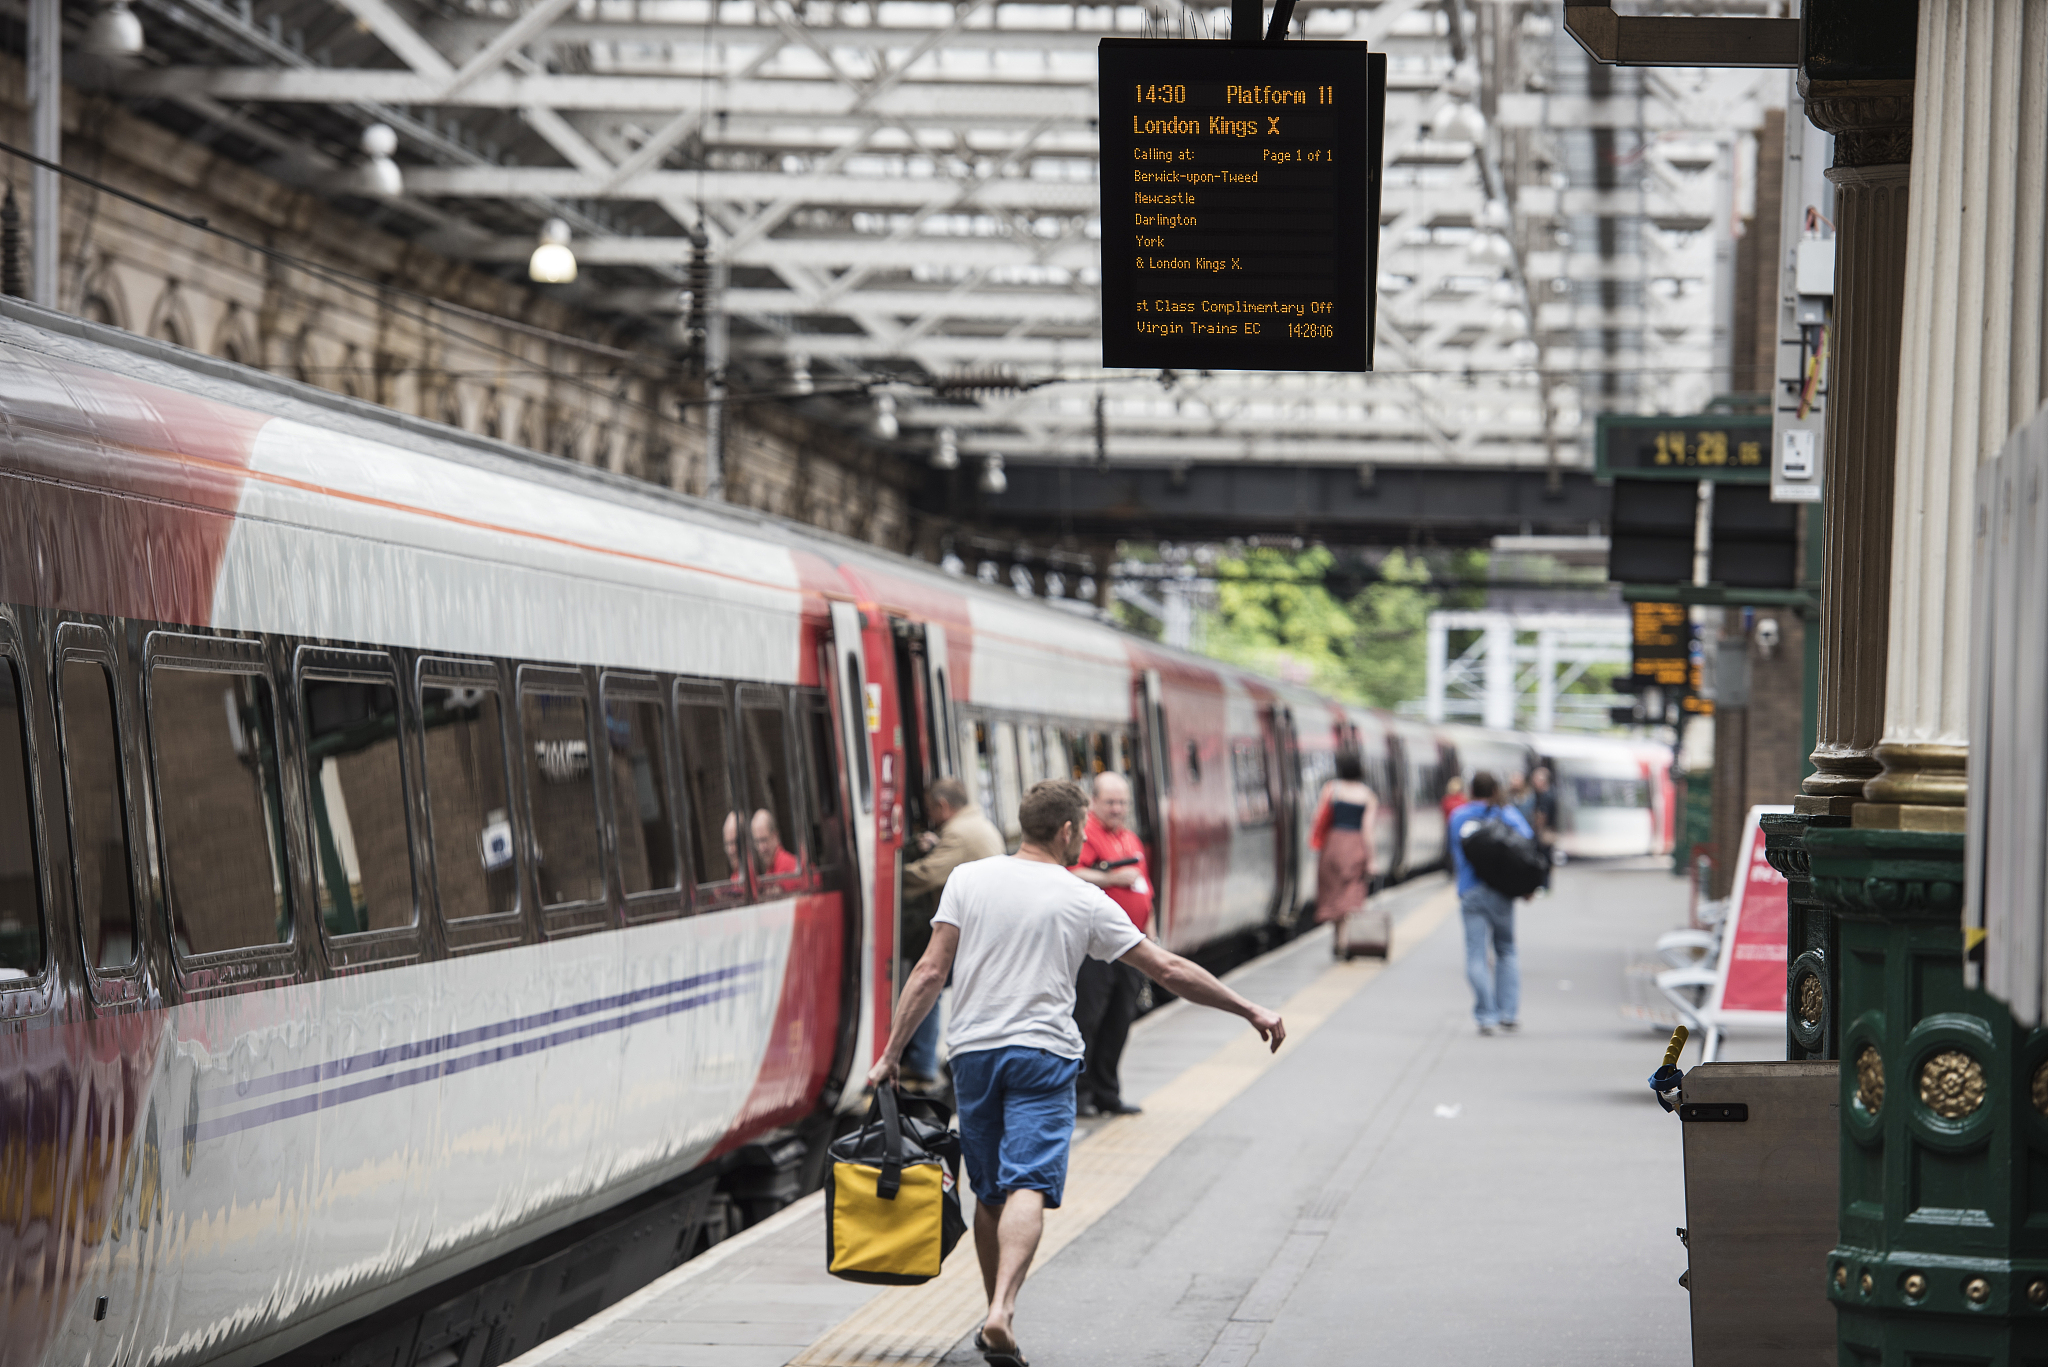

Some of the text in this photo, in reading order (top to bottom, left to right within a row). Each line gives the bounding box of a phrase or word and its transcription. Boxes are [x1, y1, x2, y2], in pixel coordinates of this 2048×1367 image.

[1135, 84, 1333, 105] 14:30 Platform 11
[1133, 115, 1280, 138] London Kings X
[1133, 147, 1333, 165] Calling at: Page 1 of 1
[1134, 169, 1258, 186] Berwick-upon-Tweed
[1134, 191, 1195, 205] Newcastle
[1135, 213, 1197, 229] Darlington
[1135, 234, 1165, 248] York
[1135, 256, 1243, 273] & London Kings X.
[1154, 299, 1195, 312] Class
[1200, 300, 1305, 317] Complimentary
[1136, 320, 1334, 339] Virgin Trains EC 14:28:06
